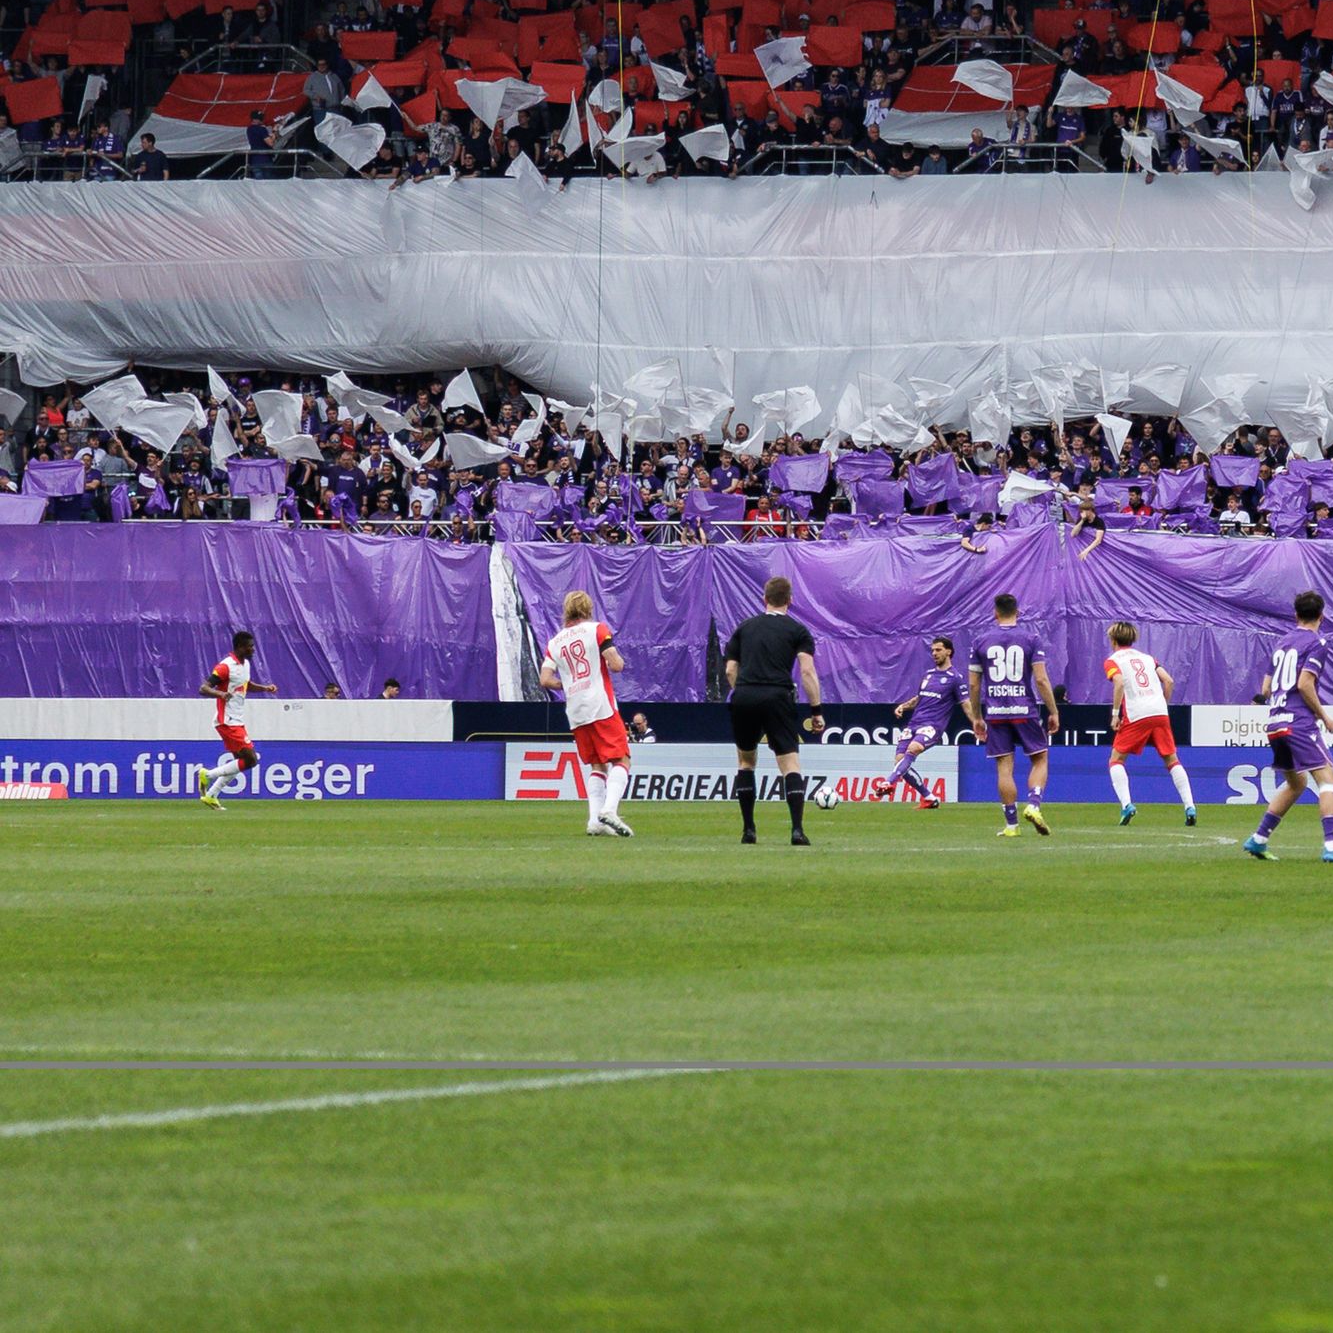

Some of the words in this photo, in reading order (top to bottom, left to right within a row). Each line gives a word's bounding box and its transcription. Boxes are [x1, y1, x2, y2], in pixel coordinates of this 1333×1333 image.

[561, 640, 590, 683] 18
[987, 645, 1024, 682] 30
[1130, 659, 1149, 687] 8
[1271, 648, 1298, 692] 20
[988, 685, 1026, 697] FISCHER
[132, 753, 206, 794] für
